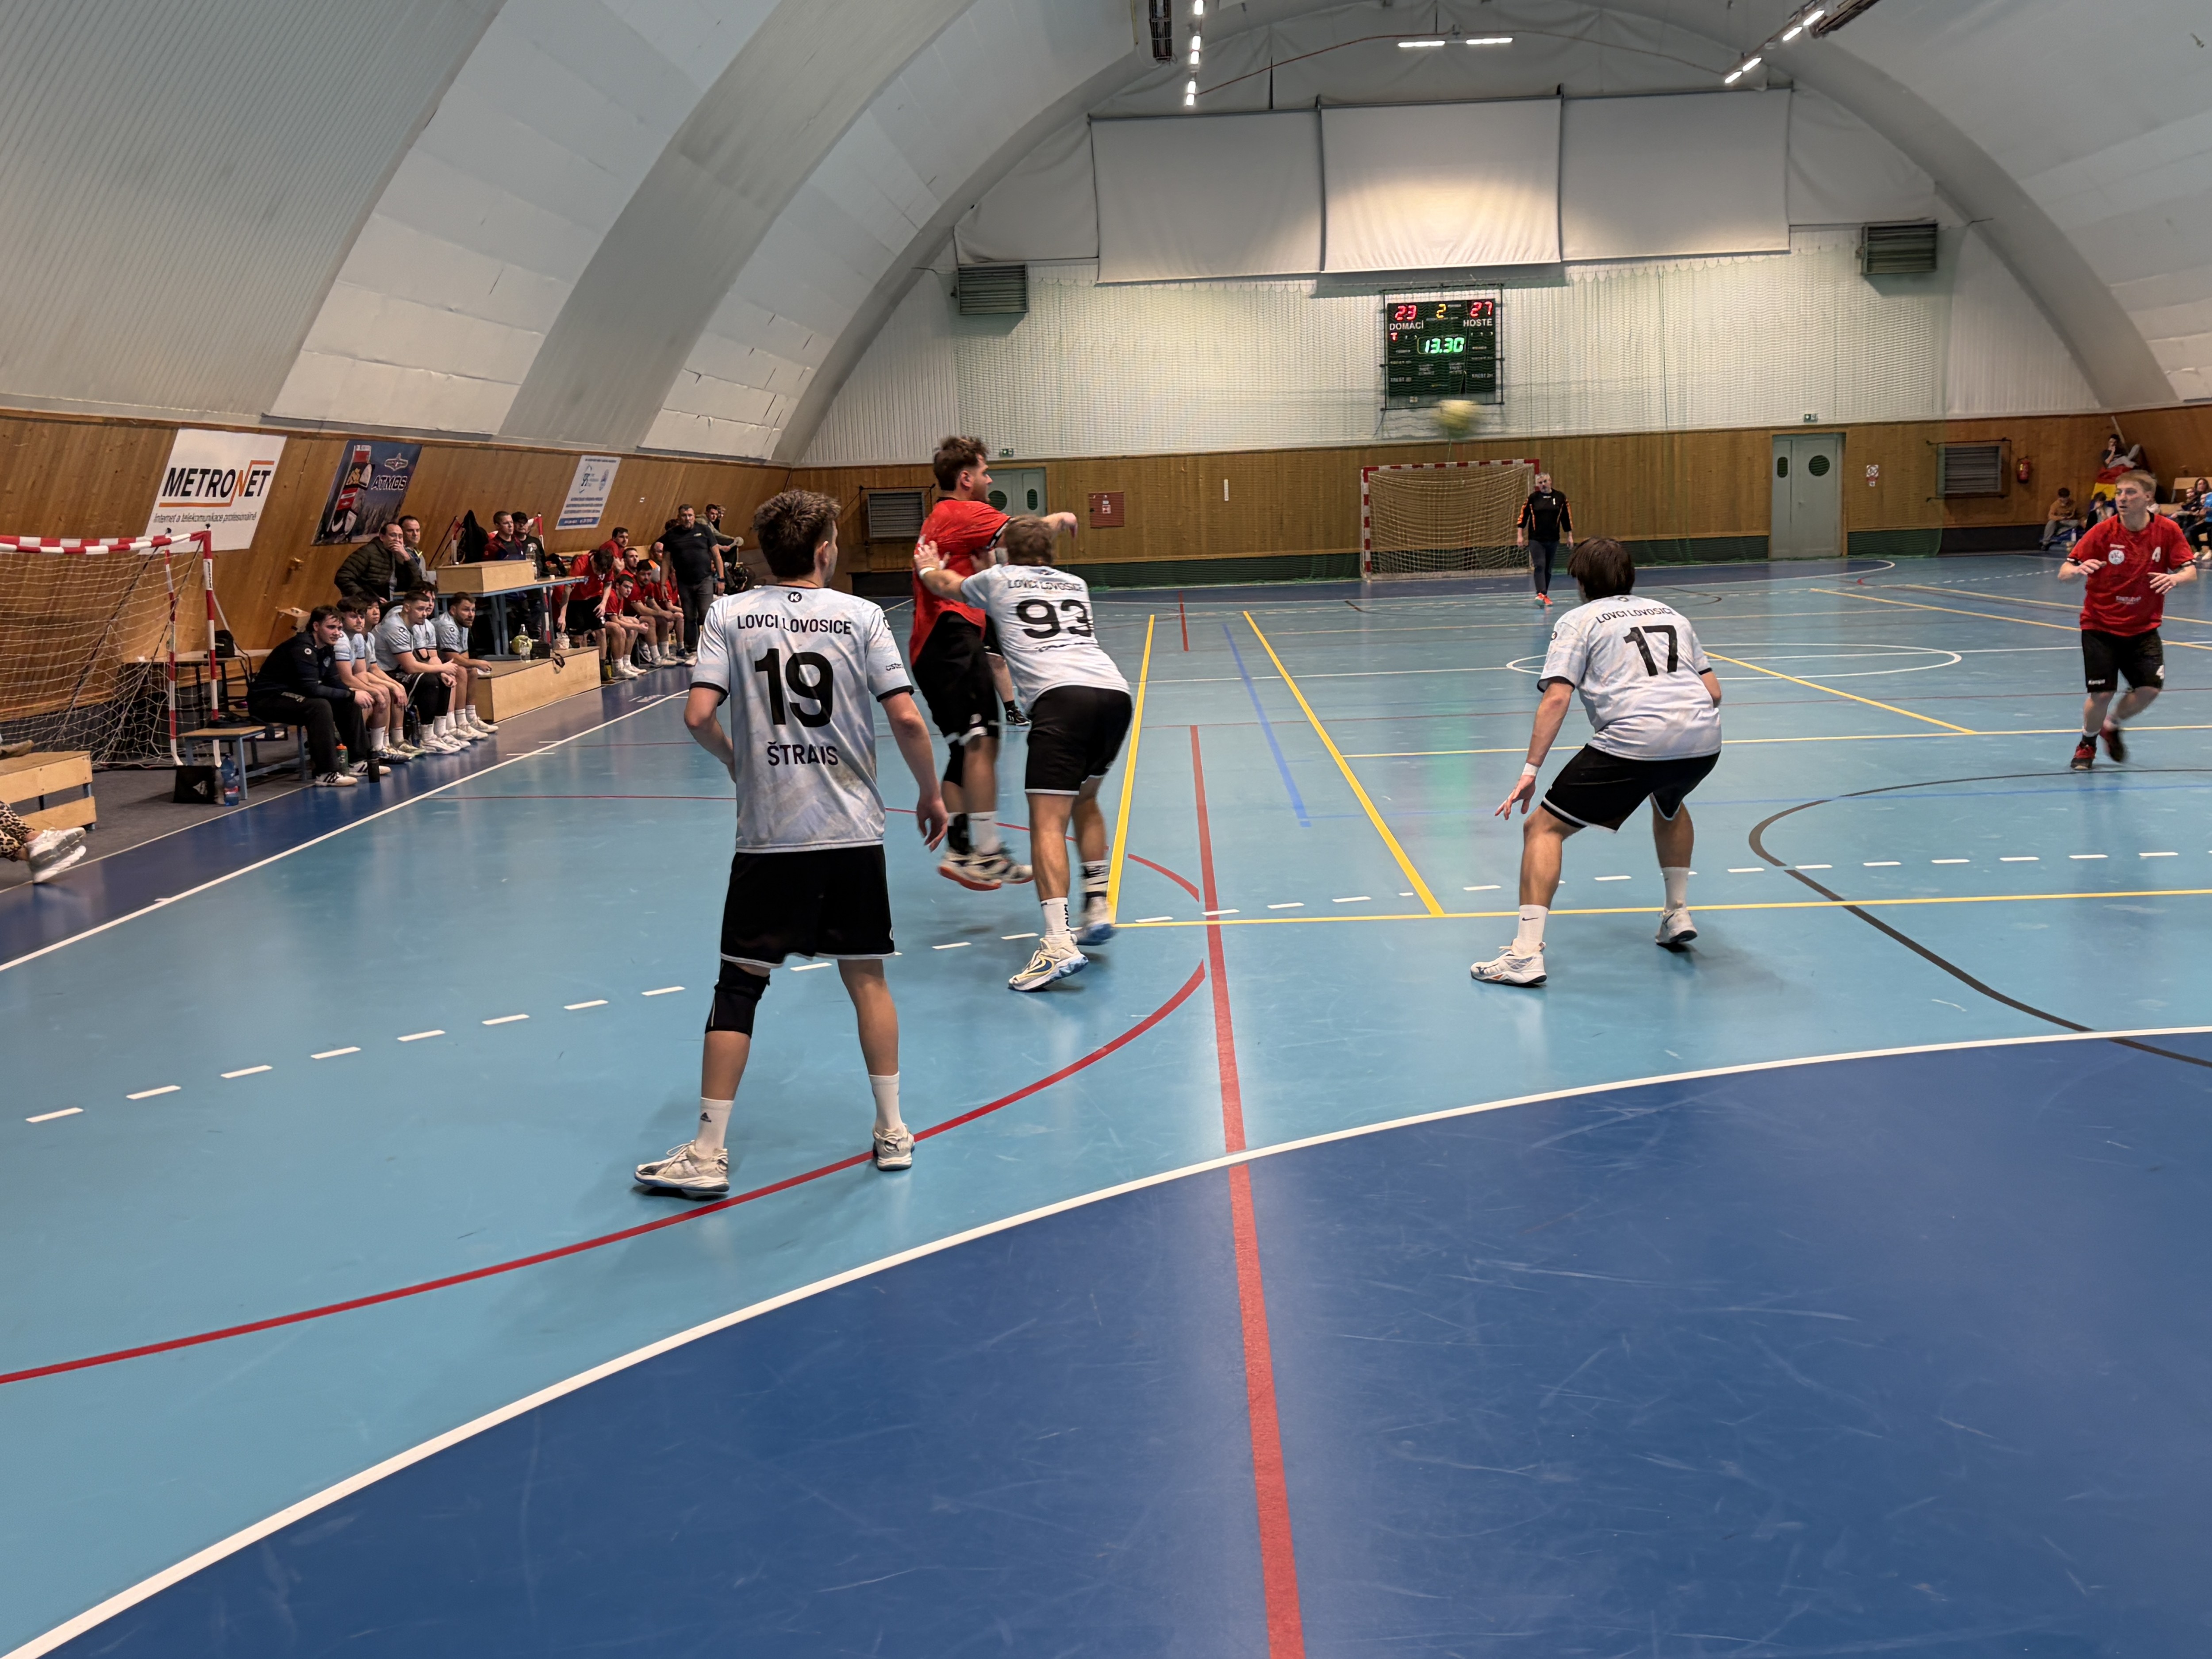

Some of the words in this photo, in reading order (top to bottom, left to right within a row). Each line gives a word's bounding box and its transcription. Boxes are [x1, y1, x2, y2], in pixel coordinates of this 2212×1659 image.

[1394, 305, 1417, 321] 23
[1436, 303, 1447, 319] 2
[1470, 301, 1493, 317] 27
[1390, 319, 1424, 331] DOMÁCÍ
[162, 467, 272, 498] METRONET
[371, 475, 407, 491] ATMOS
[2151, 546, 2161, 563] 4
[737, 614, 778, 629] LOVCI
[782, 617, 852, 635] LOVOSICE
[1016, 599, 1092, 639] 93
[1595, 611, 1628, 624] LOVCI
[1623, 625, 1678, 677] 17
[754, 648, 833, 727] 19
[767, 741, 839, 766] ŠTRAIS
